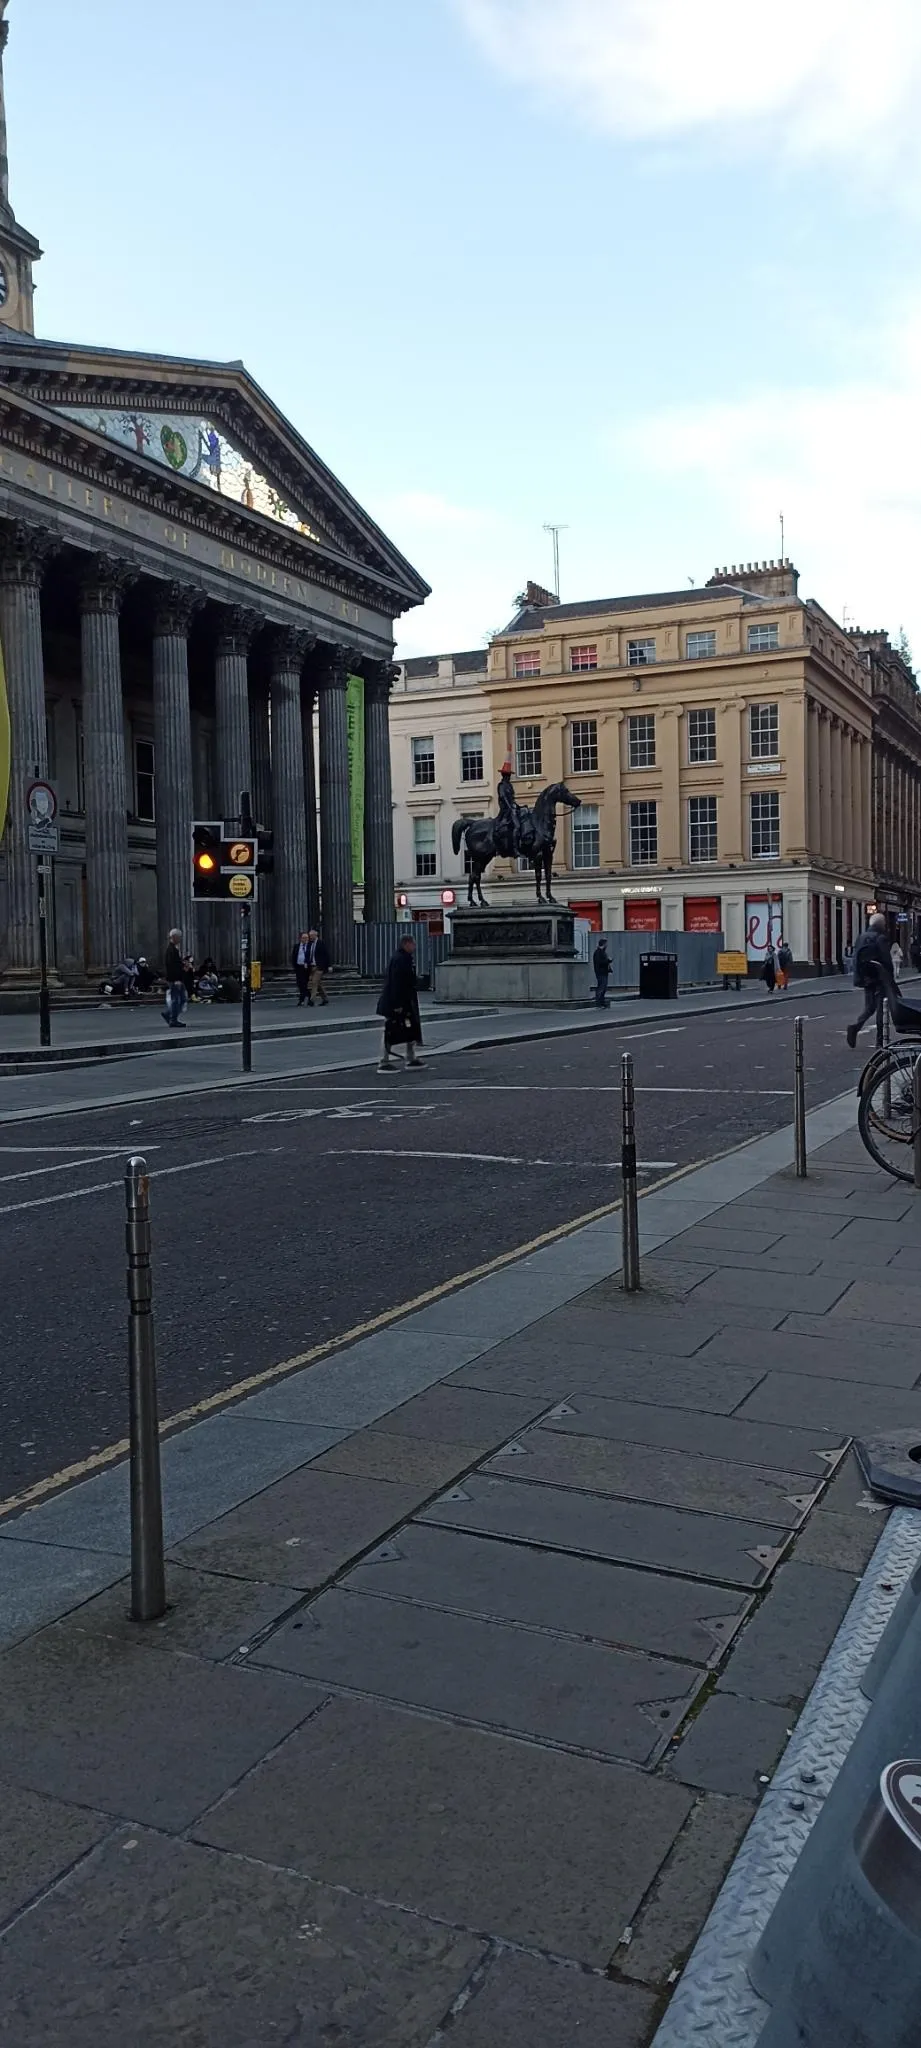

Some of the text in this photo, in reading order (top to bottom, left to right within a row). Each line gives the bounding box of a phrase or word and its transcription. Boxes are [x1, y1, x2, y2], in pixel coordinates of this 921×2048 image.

[164, 523, 192, 550] OF
[219, 547, 310, 598] MODERN
[327, 594, 361, 624] ART
